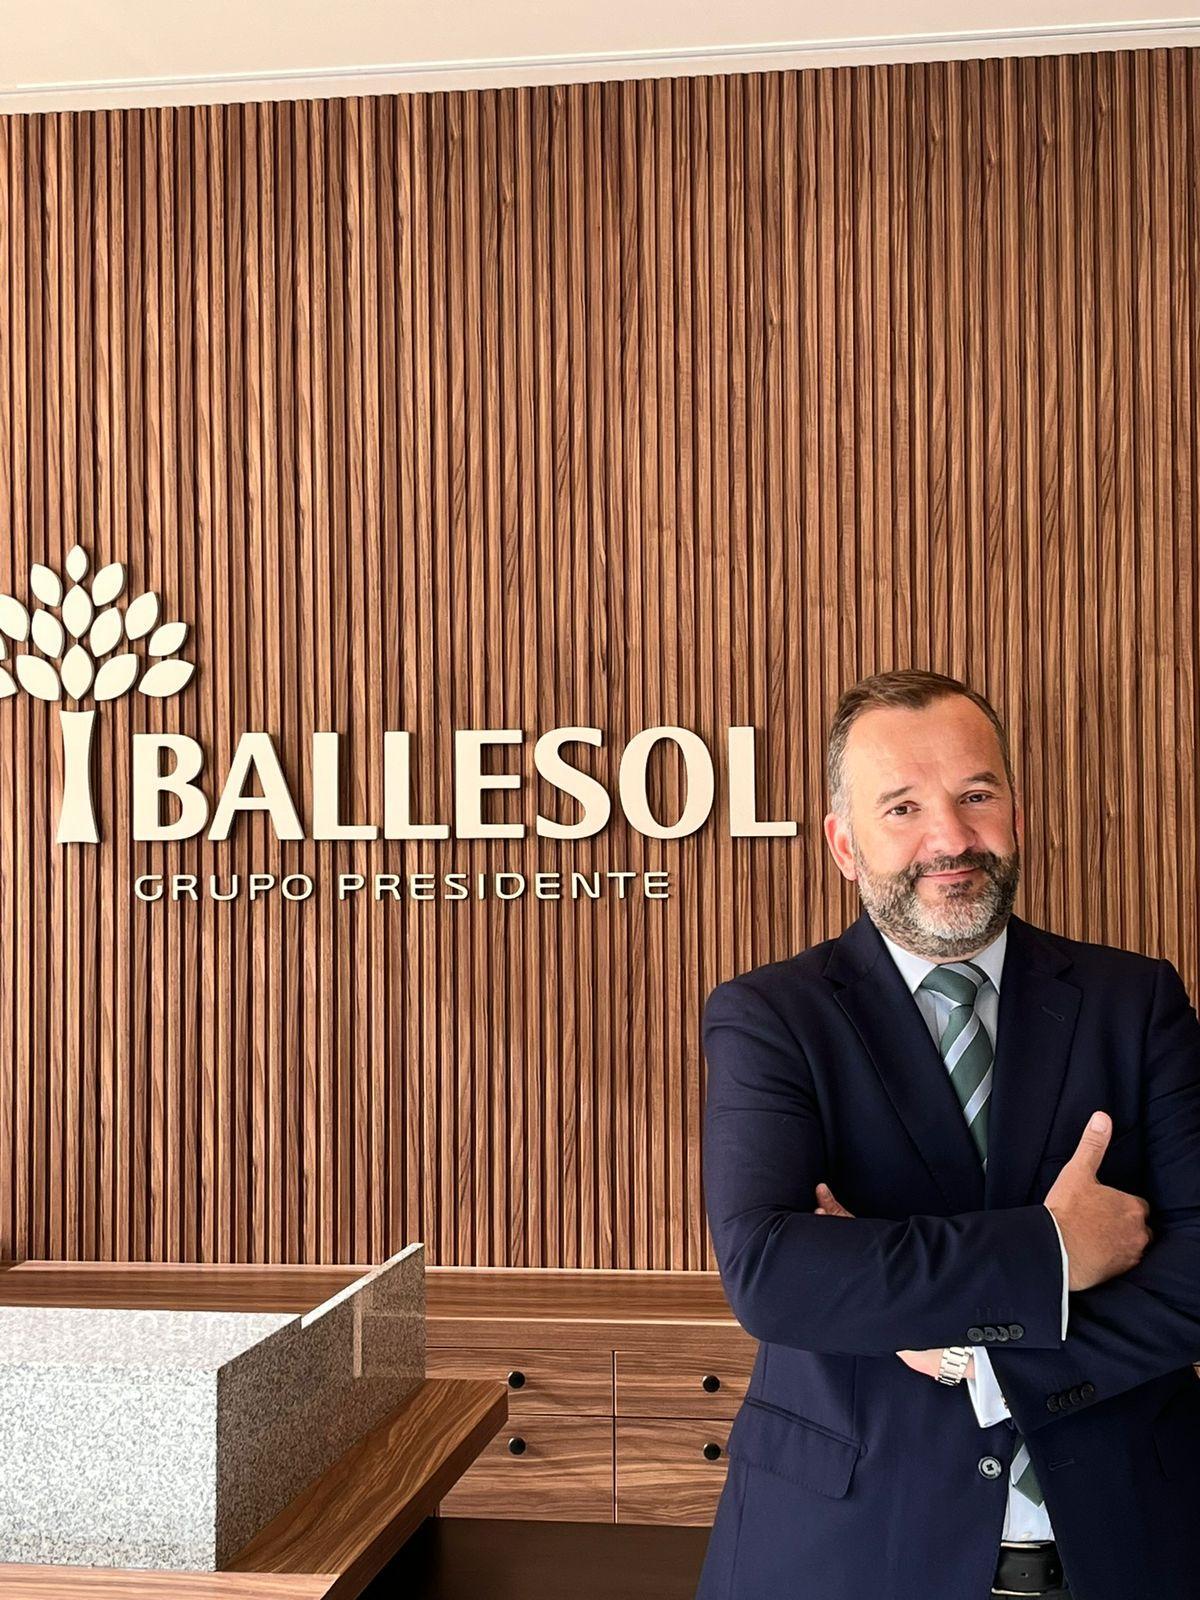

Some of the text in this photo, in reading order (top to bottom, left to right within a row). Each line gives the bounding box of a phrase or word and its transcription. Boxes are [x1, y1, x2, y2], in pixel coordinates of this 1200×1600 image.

[132, 725, 798, 842] BALLESOL
[133, 870, 671, 903] GRUPO PRESIDENTE
